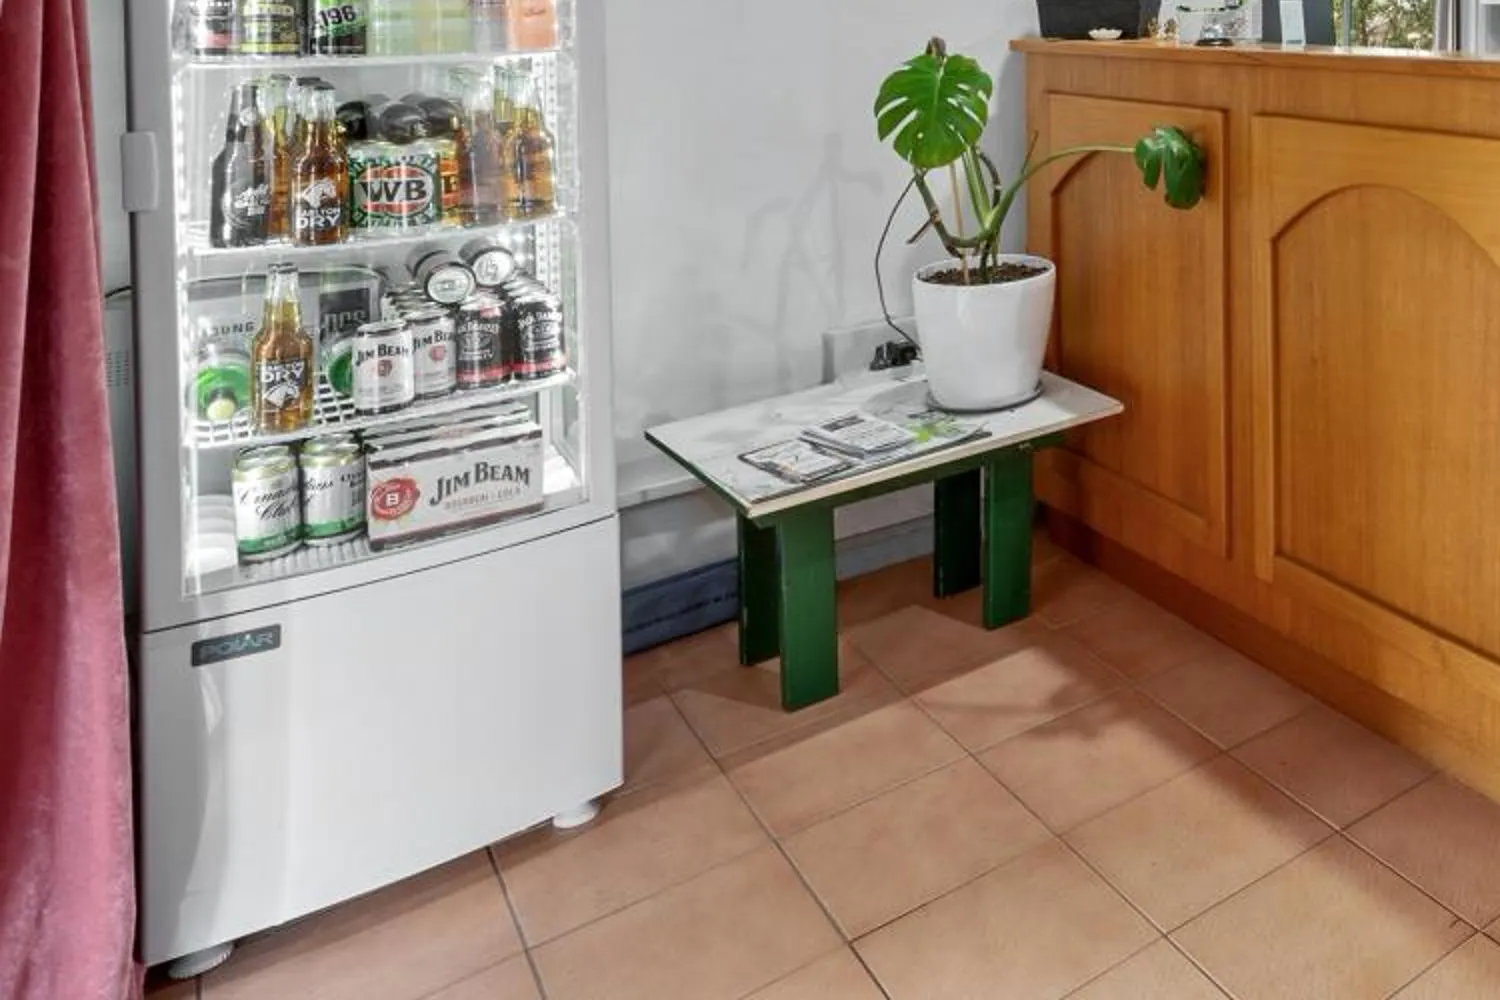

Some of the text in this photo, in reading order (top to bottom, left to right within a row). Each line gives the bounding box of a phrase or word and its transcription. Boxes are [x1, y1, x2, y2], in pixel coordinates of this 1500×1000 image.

[295, 214, 341, 230] DRY
[413, 335, 432, 352] JIM
[355, 350, 375, 367] JIM
[262, 364, 305, 384] DRY
[430, 461, 531, 506] JIM BEAM
